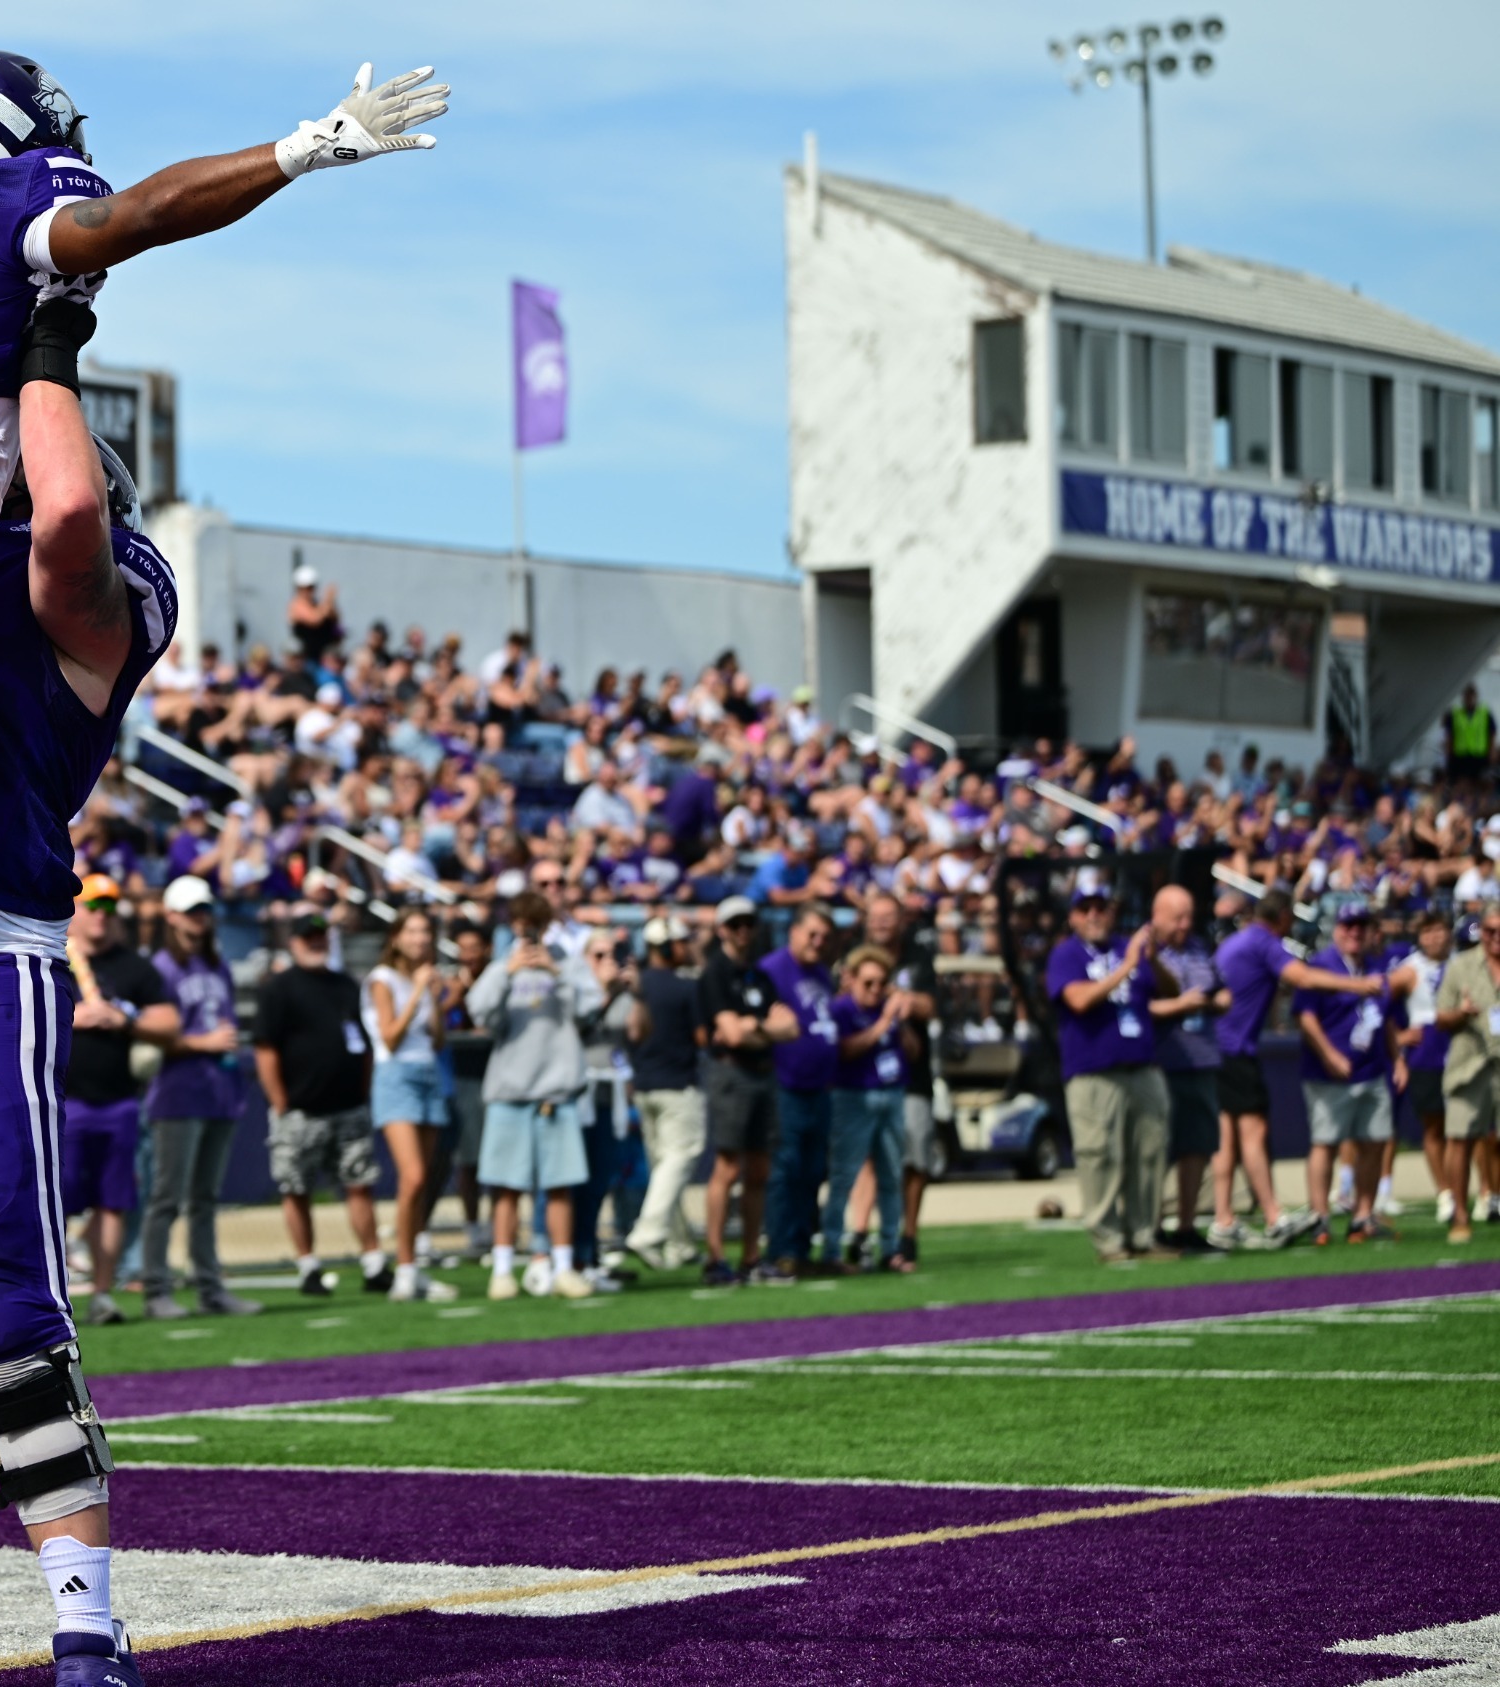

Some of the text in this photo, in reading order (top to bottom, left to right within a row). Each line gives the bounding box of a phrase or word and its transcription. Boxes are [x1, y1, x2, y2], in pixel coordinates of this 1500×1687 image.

[1104, 477, 1493, 581] HOME OF THE WARRIORS
